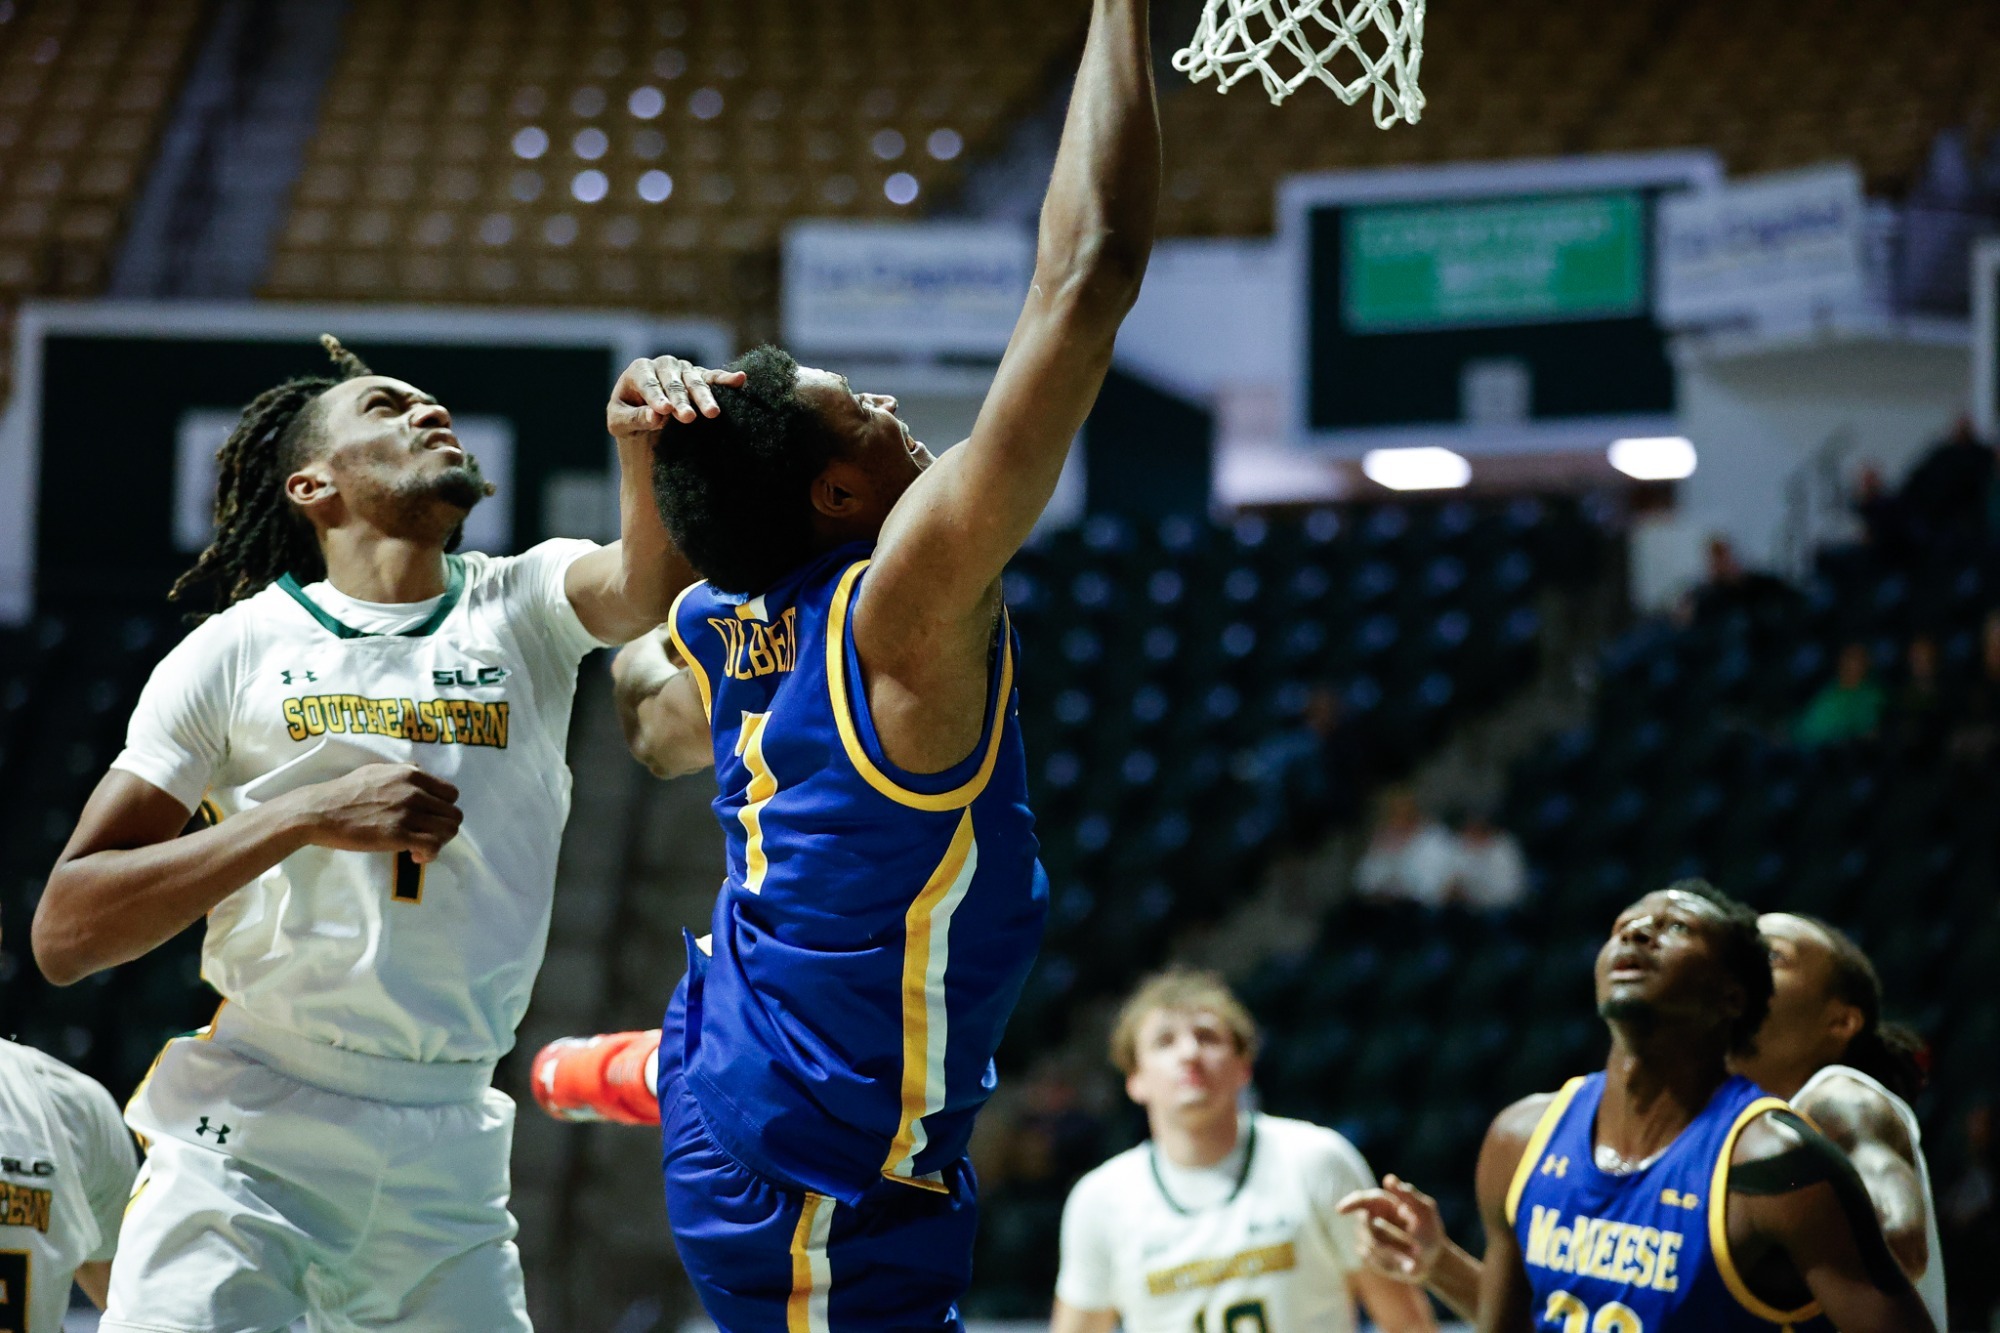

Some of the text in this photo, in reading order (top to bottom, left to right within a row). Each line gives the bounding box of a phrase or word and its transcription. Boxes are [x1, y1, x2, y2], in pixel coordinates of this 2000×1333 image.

[432, 667, 502, 686] SLC
[283, 694, 509, 749] SOUTHEASTERN
[1526, 1204, 1684, 1293] McNEESE
